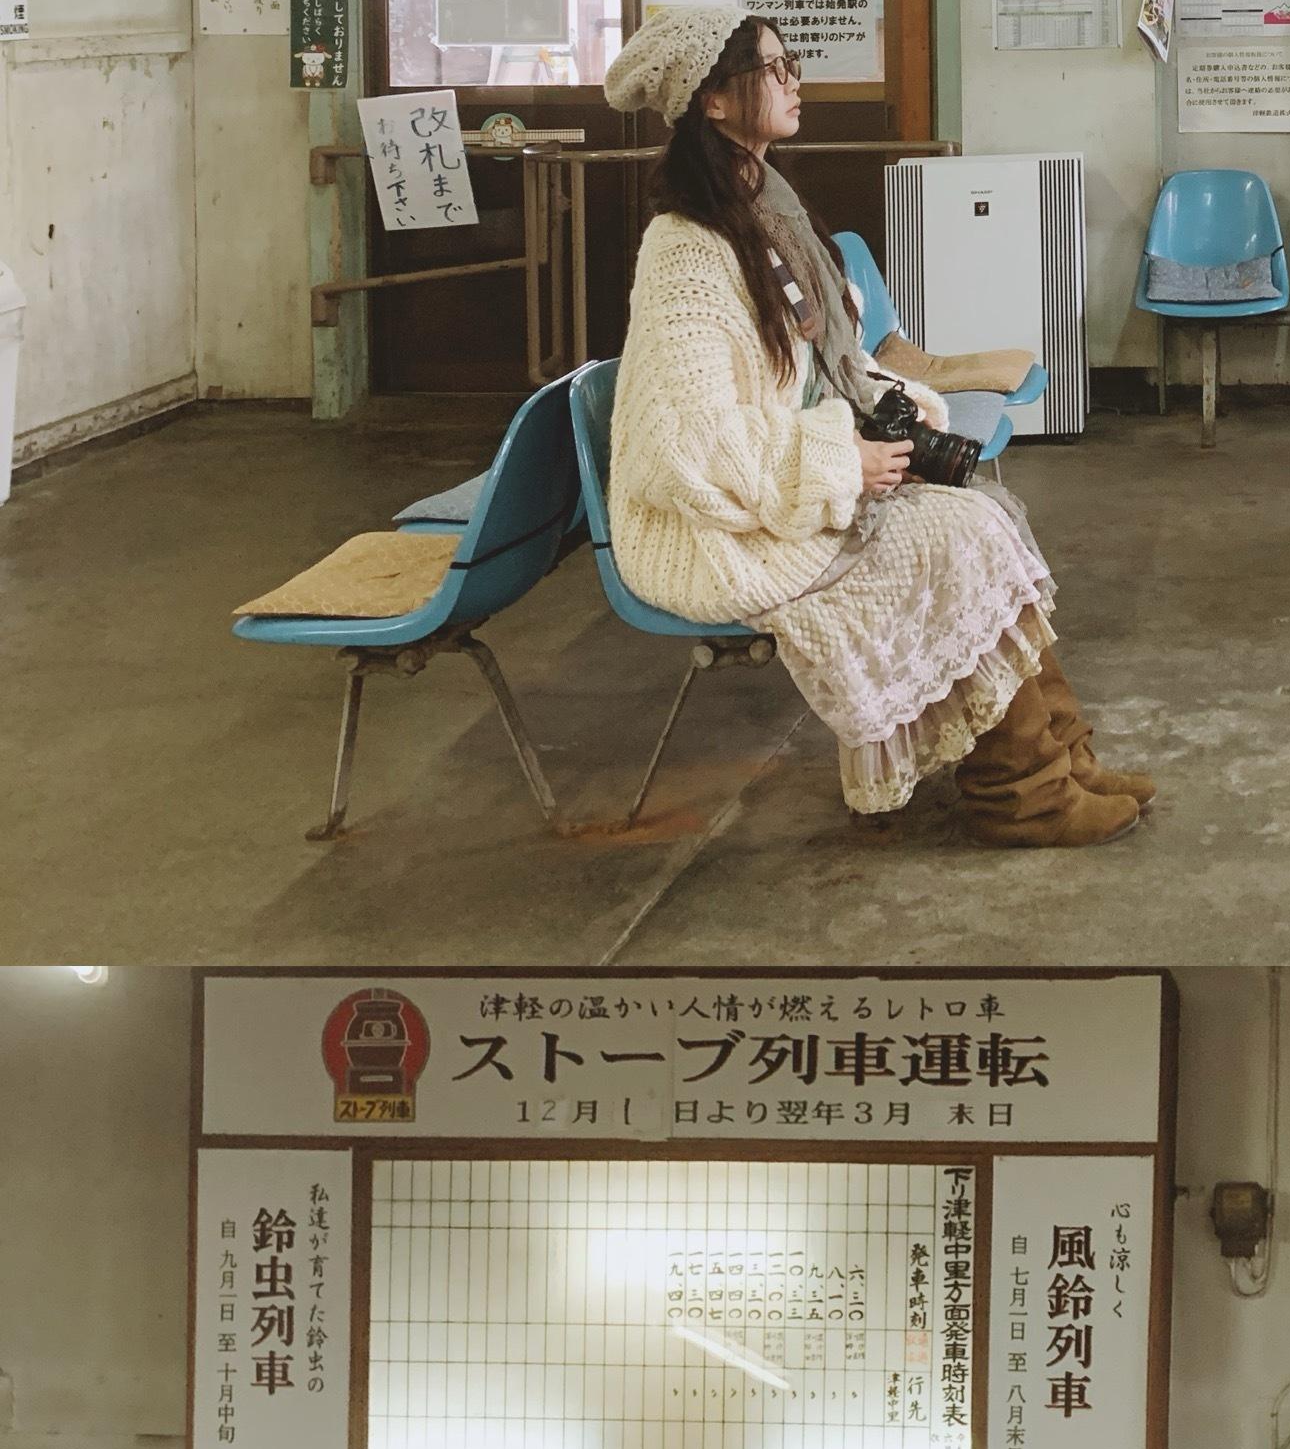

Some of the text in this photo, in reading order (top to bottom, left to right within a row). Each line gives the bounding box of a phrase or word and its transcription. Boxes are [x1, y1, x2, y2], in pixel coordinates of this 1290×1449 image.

[376, 116, 416, 230] お待ち下さい
[409, 104, 464, 225] 改札まで
[450, 1031, 1053, 1090] ストーブ列車運転
[478, 991, 1007, 1024] 津軽の温かい人情が燃えるレトロ車
[336, 1099, 413, 1121] ストーブ列車
[251, 1207, 297, 1397] 鈴虫列車
[307, 1181, 332, 1395] 私達が育てた鈴虫の
[909, 1243, 930, 1330] 発車時刻
[941, 1168, 973, 1428] 下り津軽中里方面発車時刻表
[1110, 1202, 1133, 1319] 心も涼しく
[1043, 1225, 1097, 1421] 風鈴列車
[907, 1376, 927, 1422] 行先
